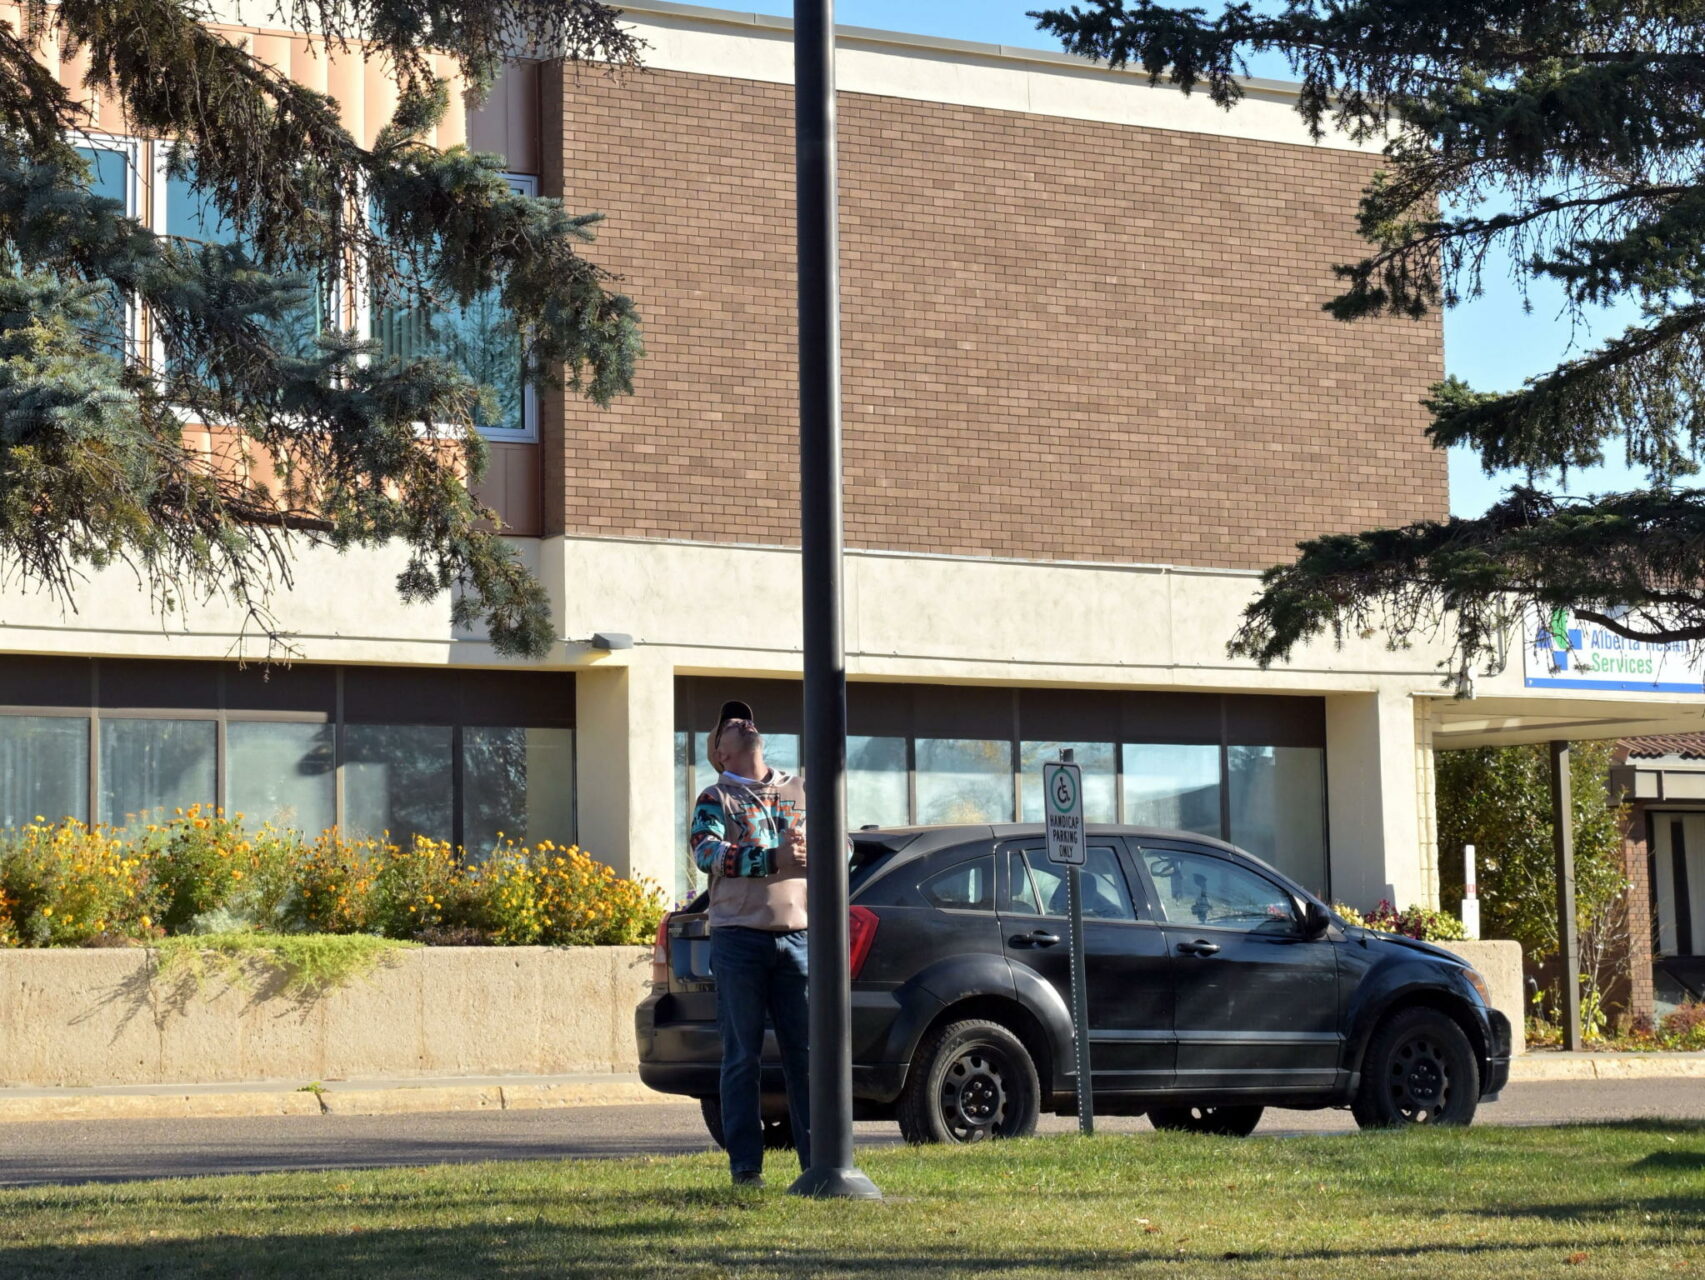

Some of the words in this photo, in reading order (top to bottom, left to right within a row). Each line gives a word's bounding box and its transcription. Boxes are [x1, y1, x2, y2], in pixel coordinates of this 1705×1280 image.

[1591, 629, 1640, 650] Alberta
[1591, 652, 1653, 674] Services
[1050, 815, 1079, 829] HANDICAP
[1053, 829, 1077, 844] PARKING
[1059, 844, 1072, 858] ONLY
